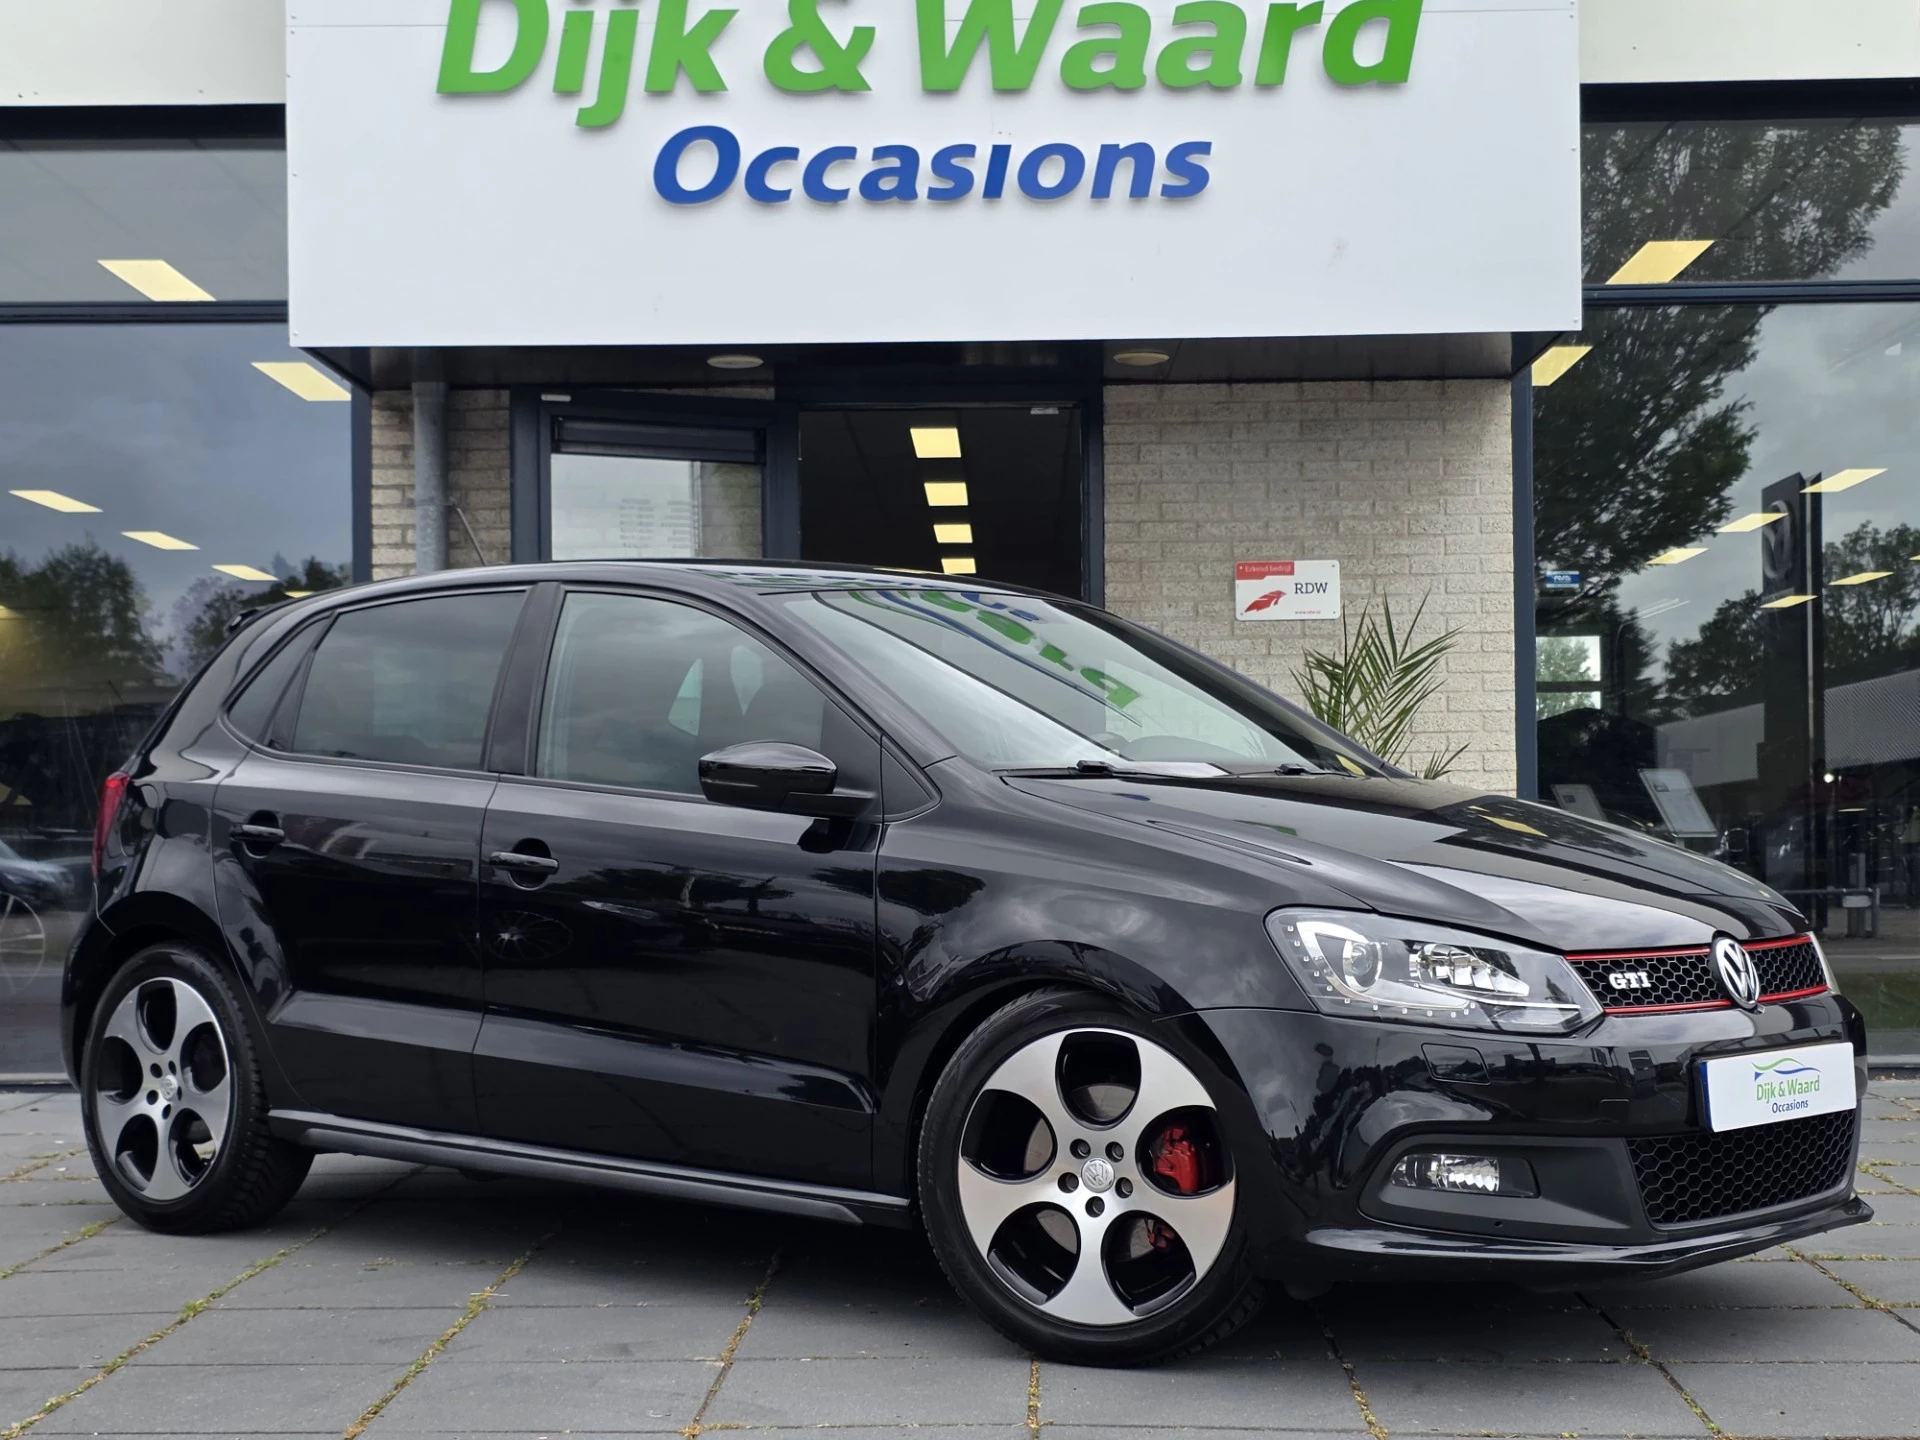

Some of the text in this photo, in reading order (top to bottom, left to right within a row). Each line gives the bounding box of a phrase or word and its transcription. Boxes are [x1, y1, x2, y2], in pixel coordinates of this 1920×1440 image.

[436, 0, 1424, 128] Dijk & Waard
[653, 125, 1212, 204] Occasions
[1294, 582, 1328, 595] RDW
[1609, 971, 1652, 990] GTI
[1756, 1074, 1820, 1104] Dijk & Waard
[1771, 1099, 1809, 1113] Occasions
